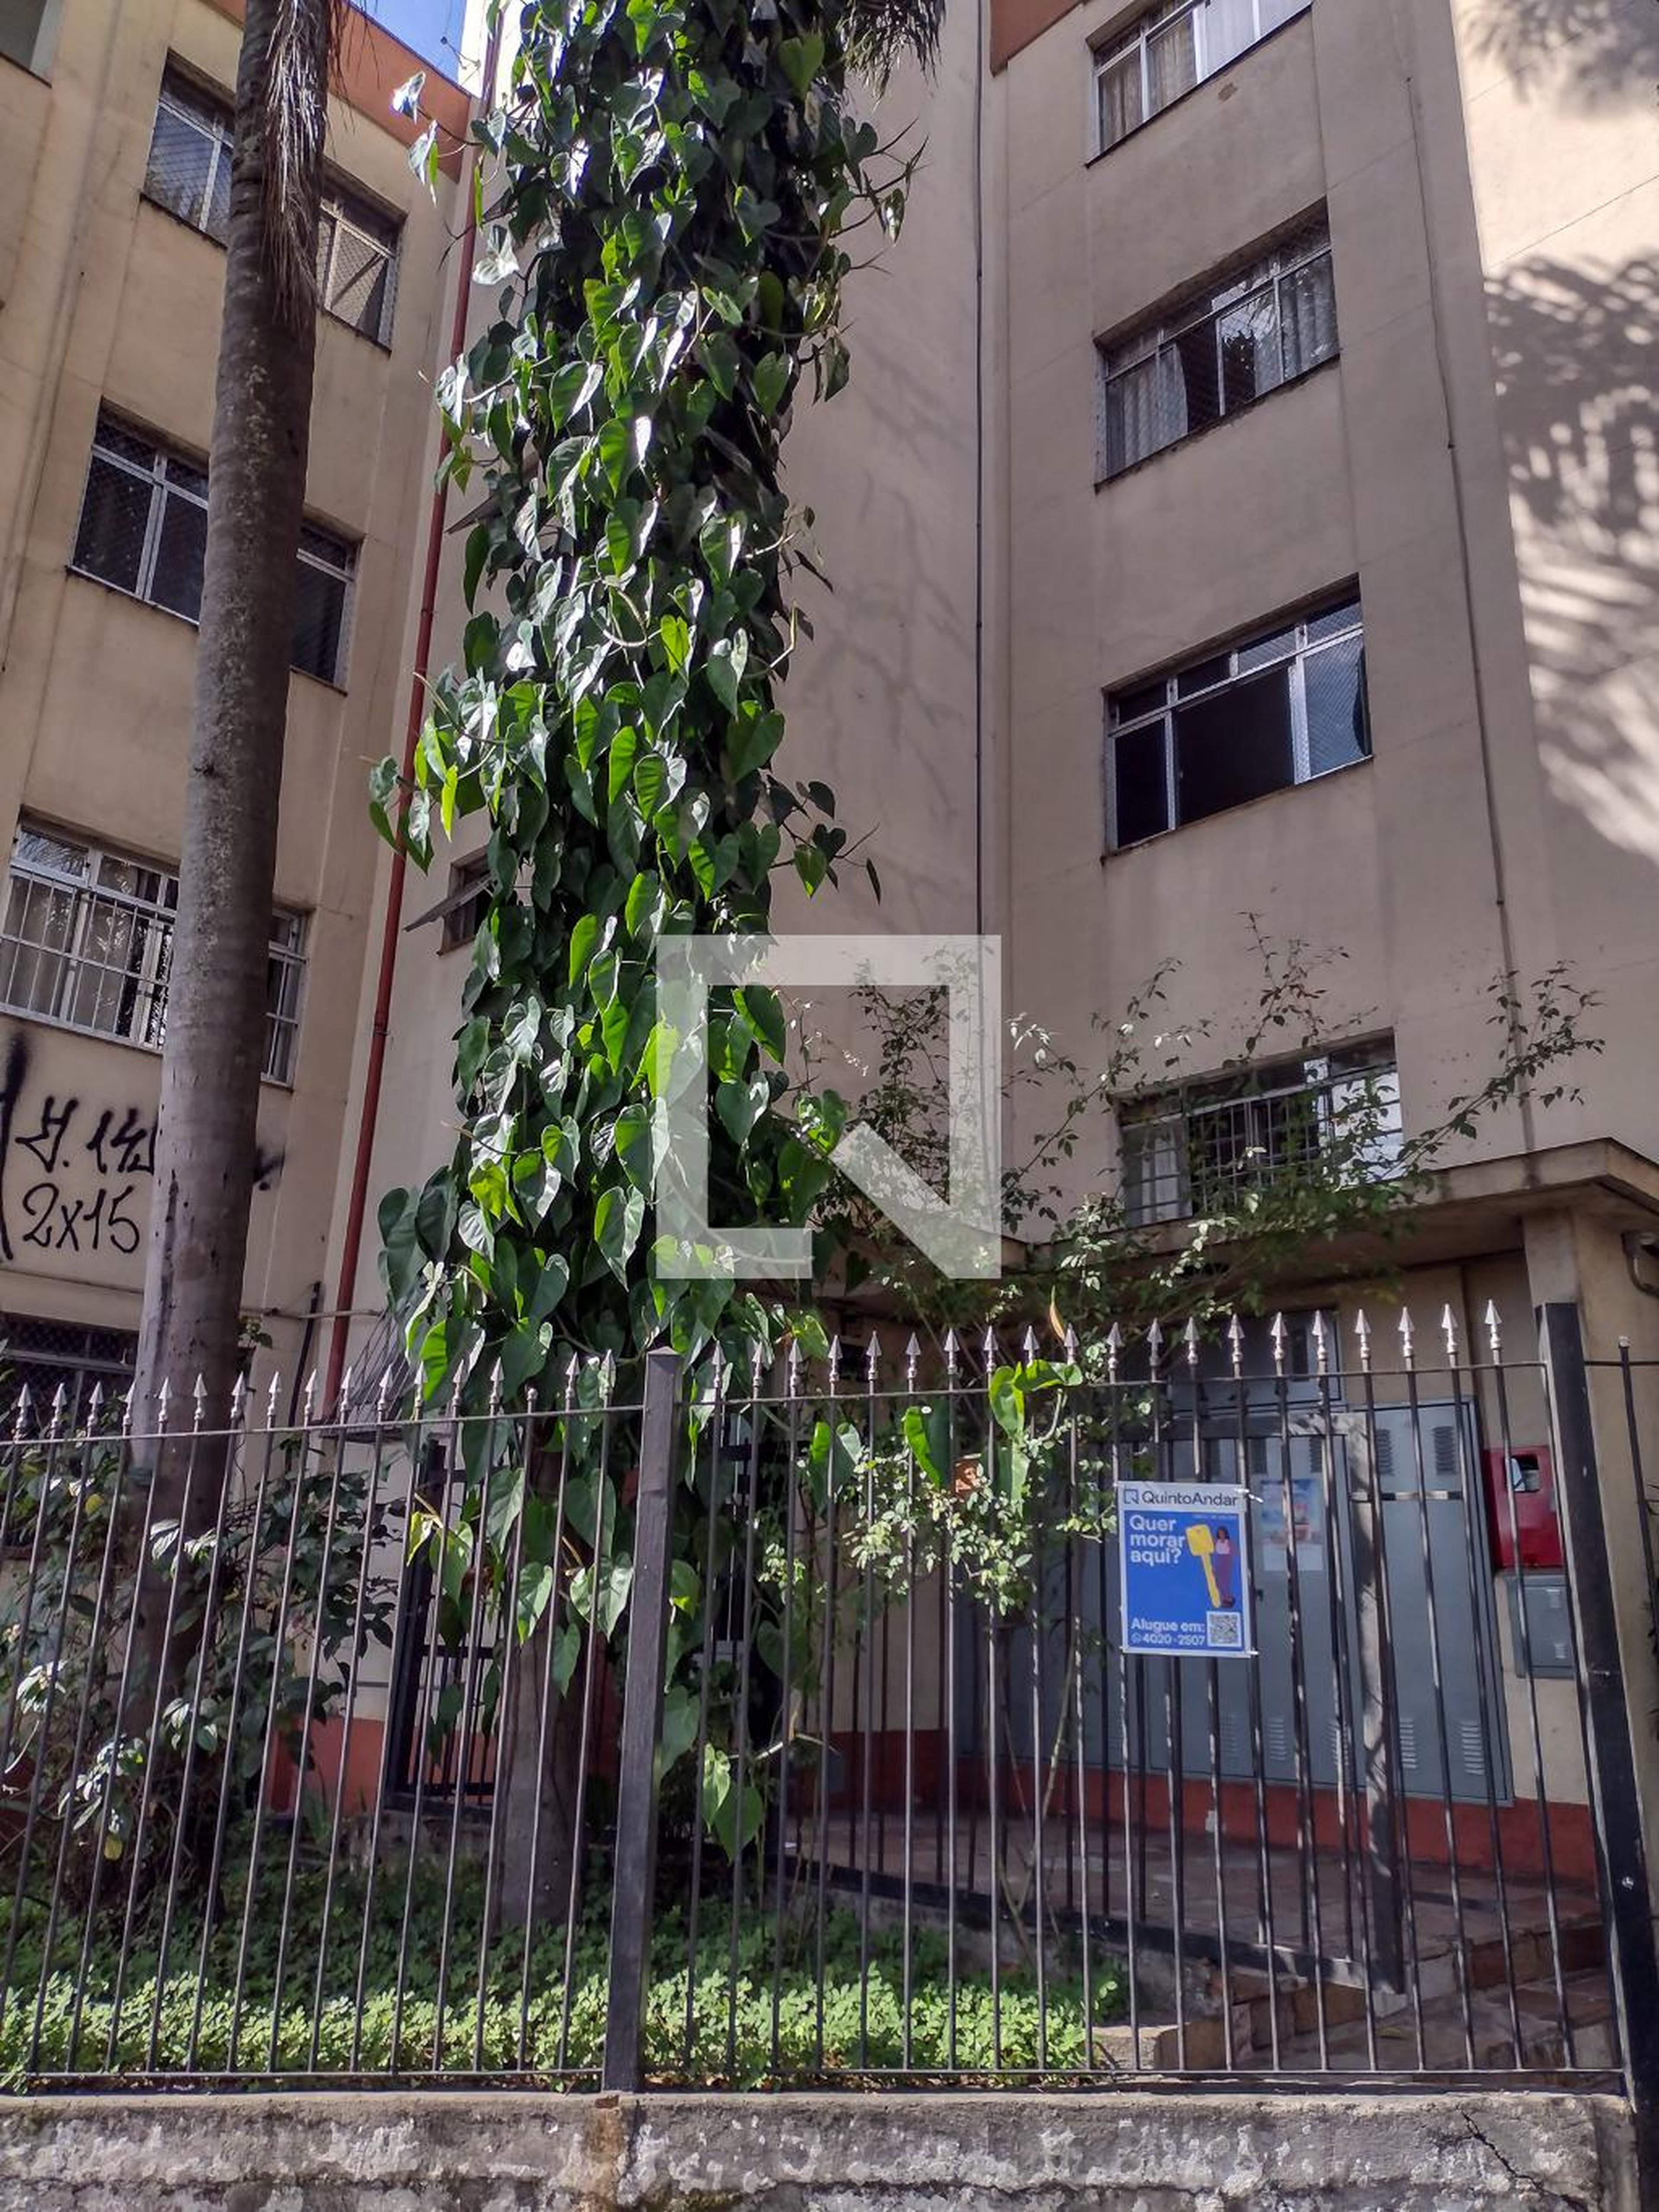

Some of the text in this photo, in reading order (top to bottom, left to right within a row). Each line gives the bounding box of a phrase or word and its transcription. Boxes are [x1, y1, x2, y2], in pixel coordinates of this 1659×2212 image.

[1142, 1490, 1239, 1506] QuintoAndar
[1129, 1515, 1176, 1531] Quer
[1131, 1534, 1185, 1548] morar
[1131, 1548, 1182, 1567] aqui?
[1131, 1617, 1205, 1633] Alugue em:
